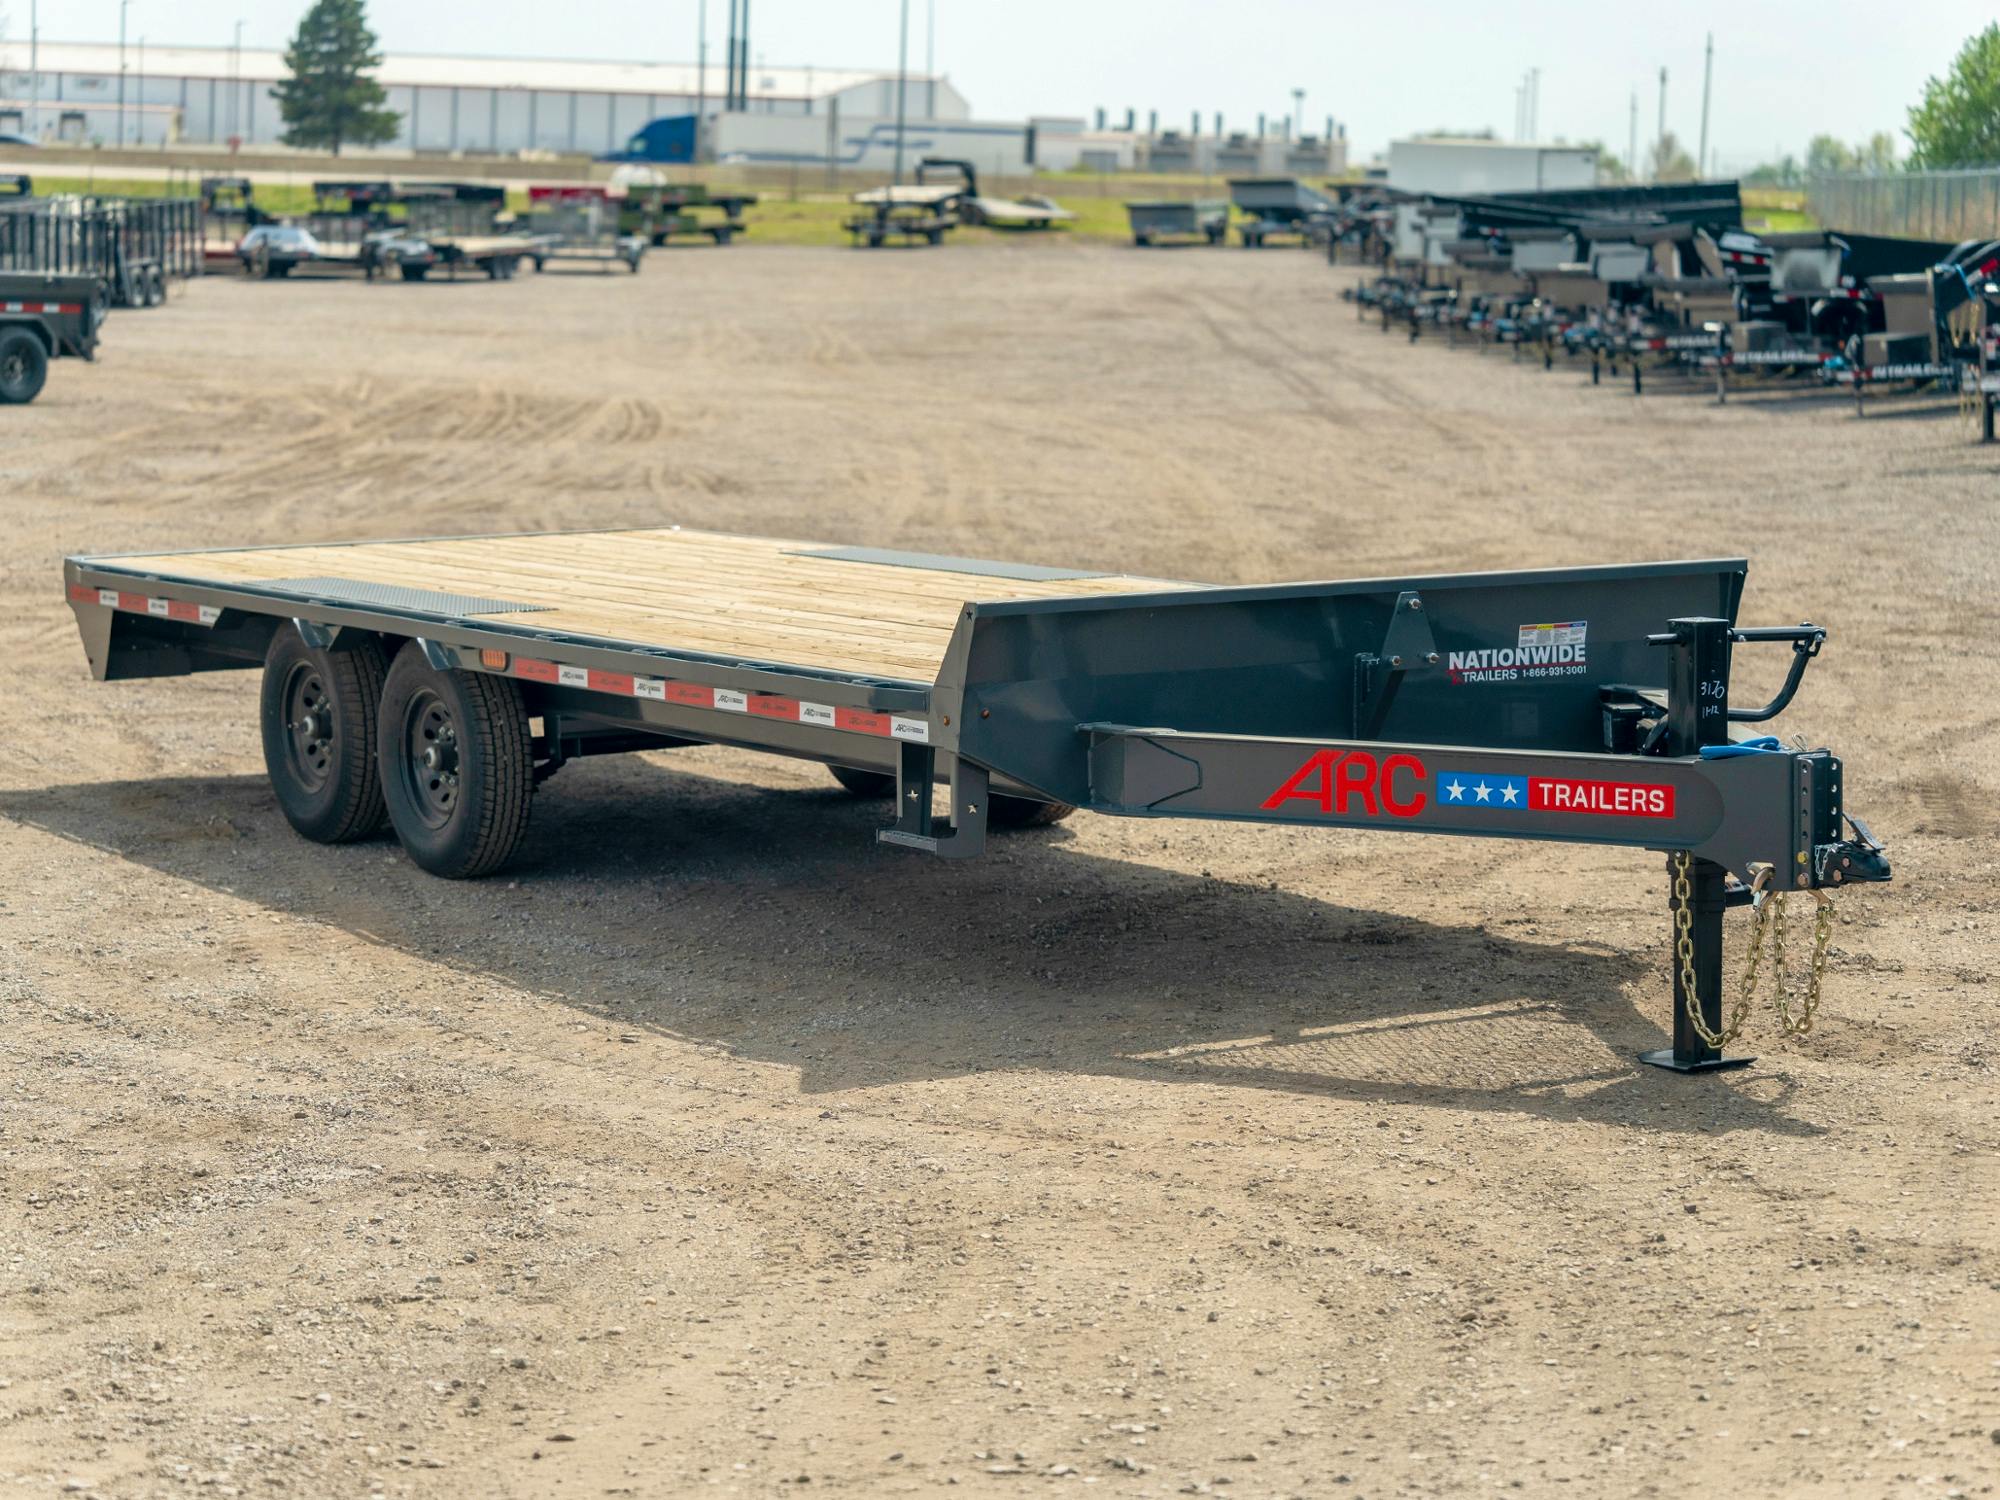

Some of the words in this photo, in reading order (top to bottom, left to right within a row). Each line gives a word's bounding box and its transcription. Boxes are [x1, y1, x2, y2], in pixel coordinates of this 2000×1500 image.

[1449, 644, 1586, 670] NATIONWIDE
[1462, 669, 1518, 683] TRAILERS
[1522, 665, 1587, 678] 1-866-931-3001
[1259, 749, 1427, 817] ARC
[1538, 782, 1665, 814] TRAILERS
